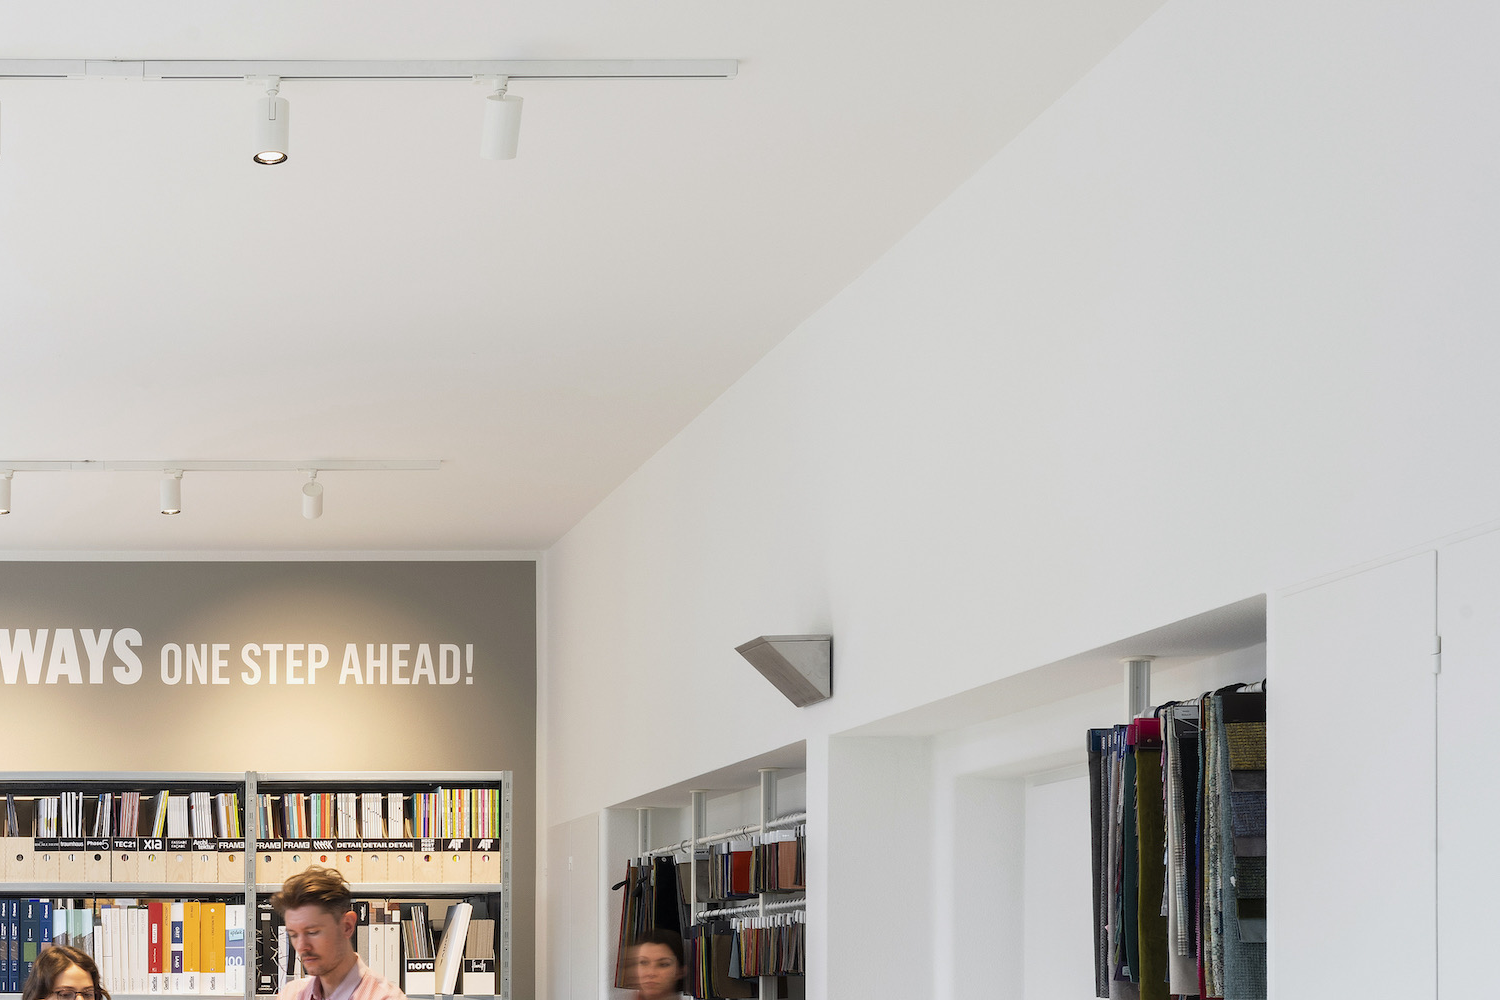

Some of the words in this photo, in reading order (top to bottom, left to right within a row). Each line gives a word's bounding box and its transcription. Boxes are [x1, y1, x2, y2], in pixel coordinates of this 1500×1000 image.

[160, 642, 230, 685] ONE
[241, 642, 329, 685] STEP
[338, 643, 474, 685] AHEAD!
[408, 962, 434, 970] nora
